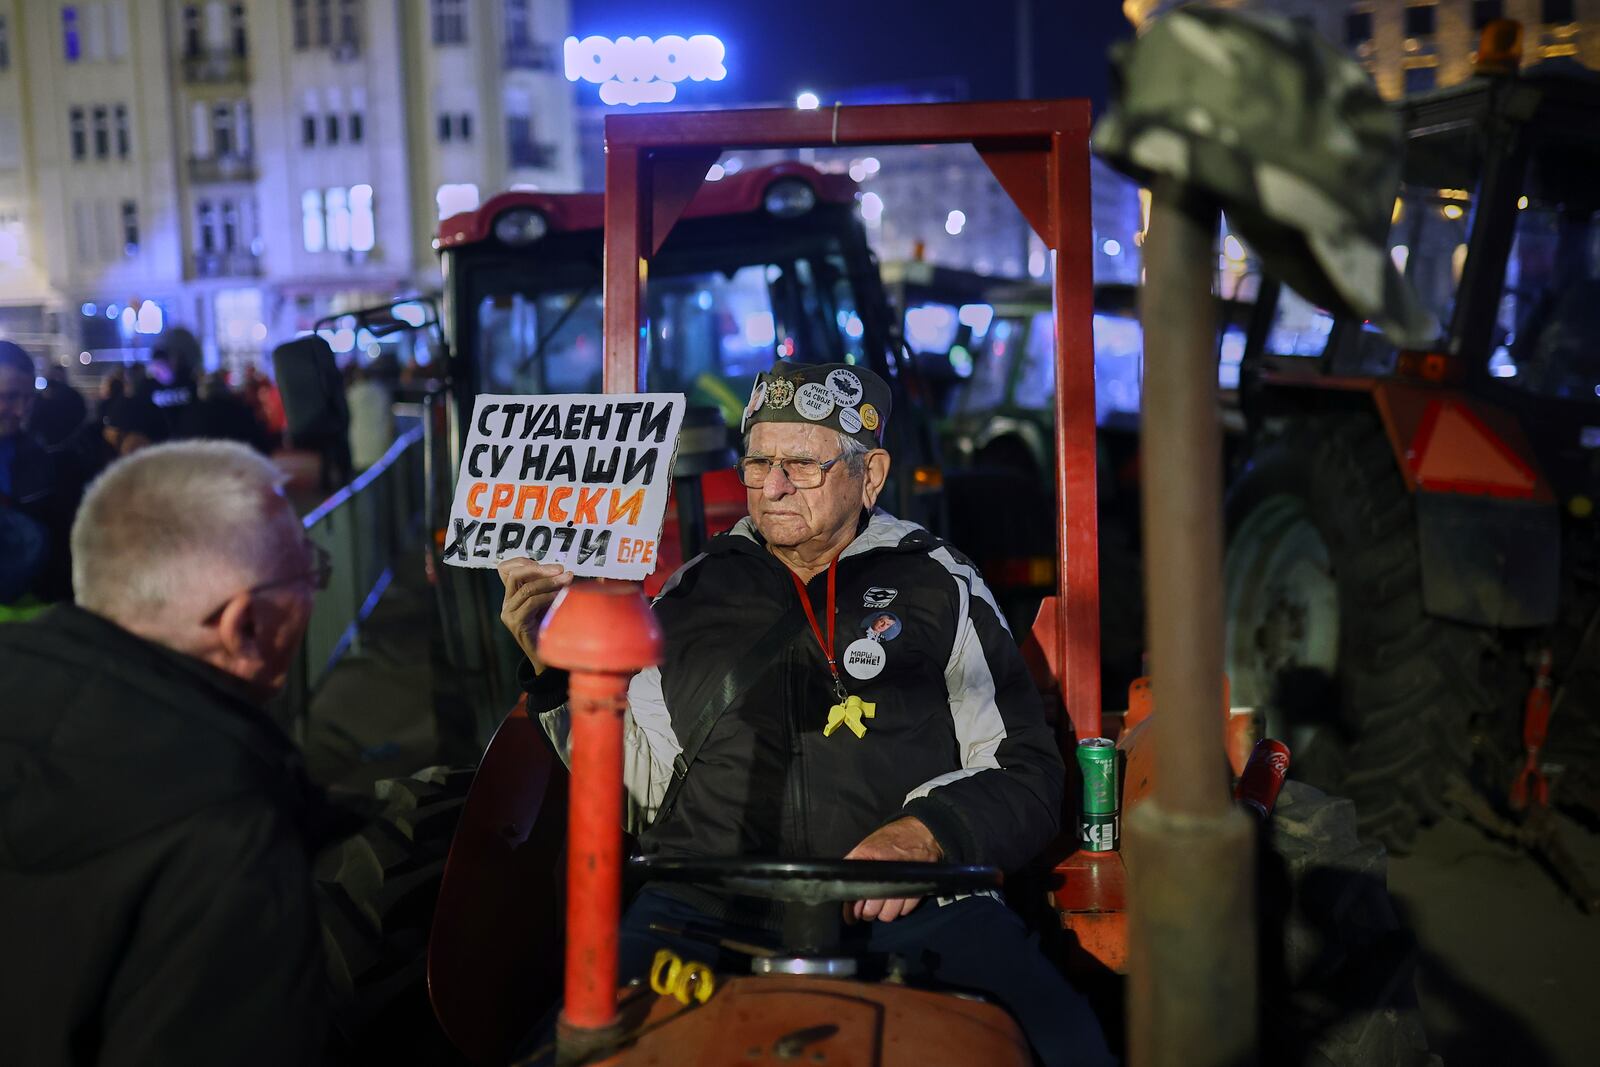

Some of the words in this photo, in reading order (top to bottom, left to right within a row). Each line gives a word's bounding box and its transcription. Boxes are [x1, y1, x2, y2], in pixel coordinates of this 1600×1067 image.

[803, 389, 812, 398] ОД
[812, 394, 831, 406] СВОЈЕ
[811, 384, 830, 397] УЧИТЕ
[806, 399, 822, 411] ДЕЦЕ
[477, 401, 674, 443] СТУДЕНТИ
[468, 443, 514, 478] СУ
[518, 444, 659, 485] НАШИ
[466, 482, 647, 526] СРПСКИ
[617, 536, 655, 564] БРЕ
[848, 655, 881, 666] ДРИНЕ!
[850, 650, 873, 659] МАРШ
